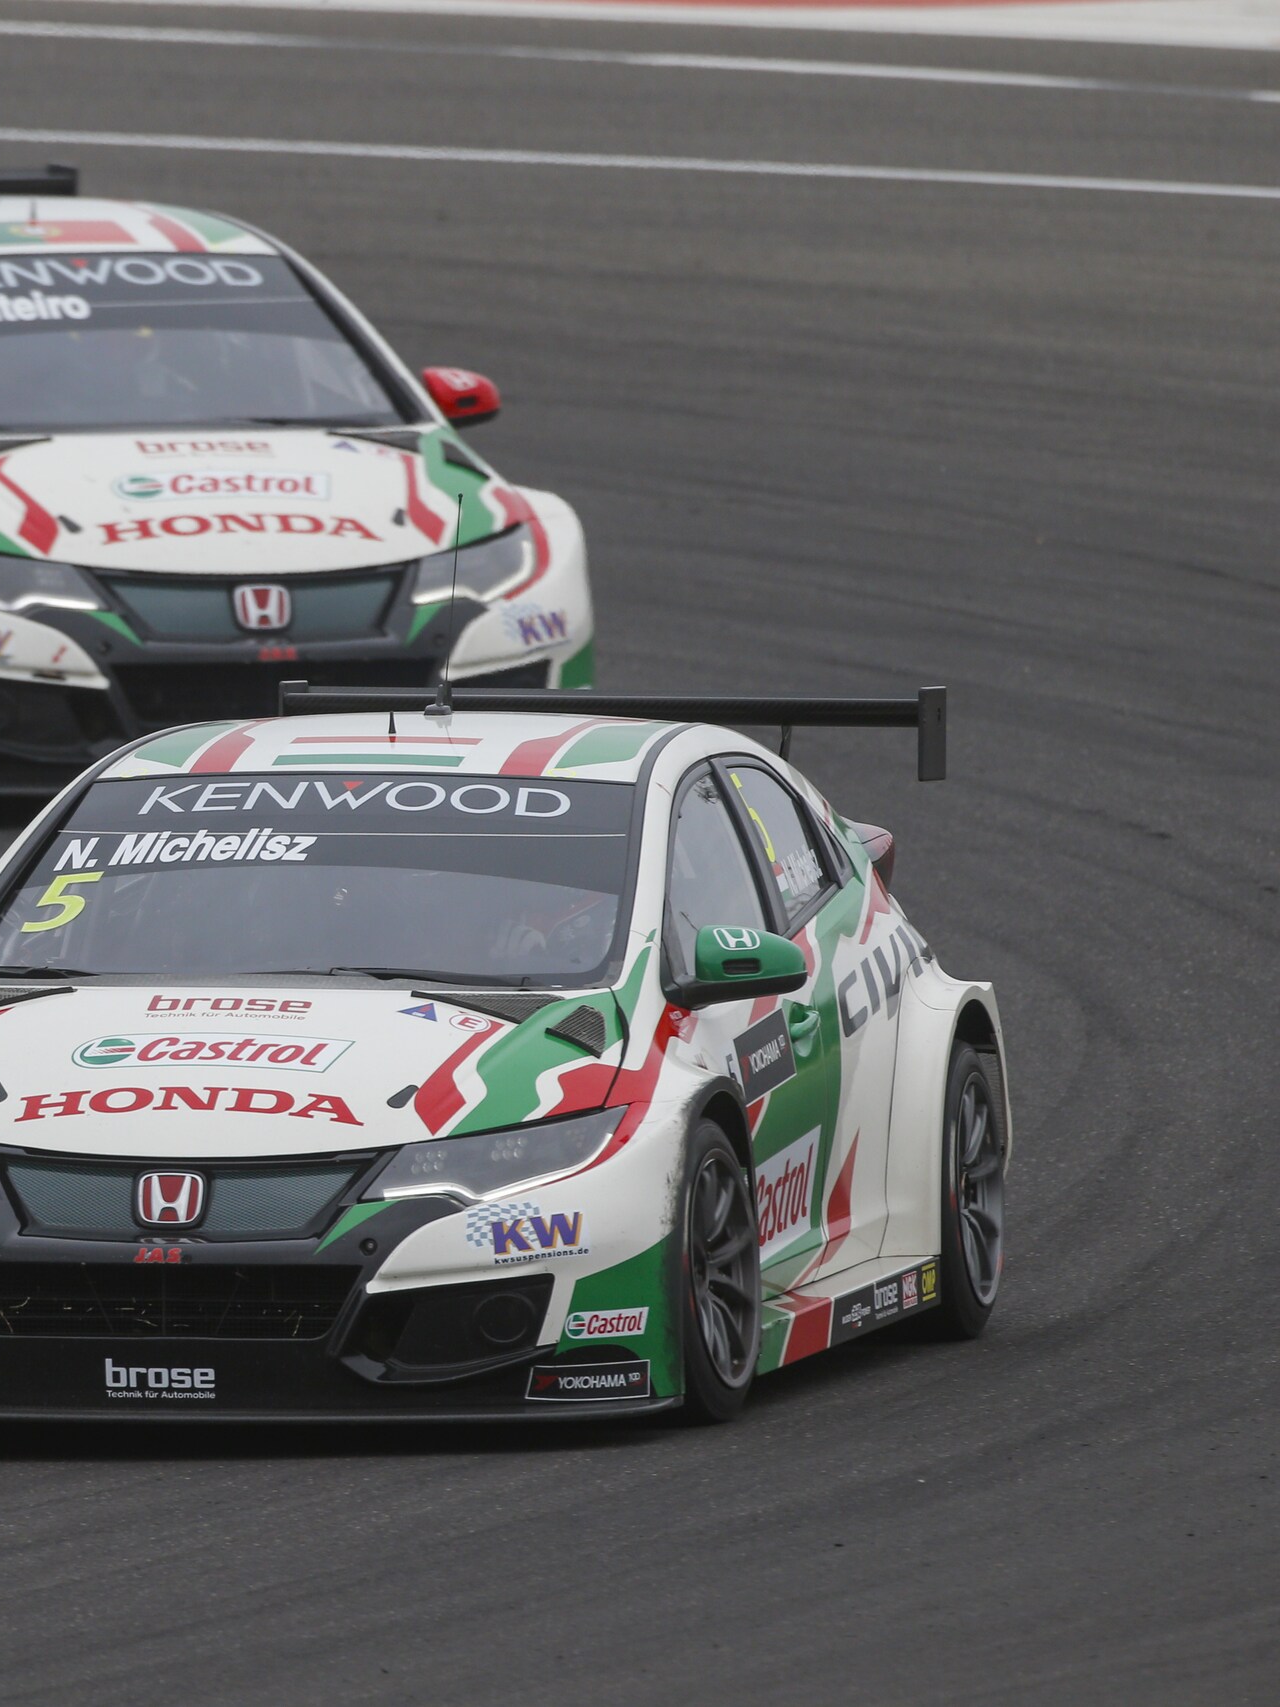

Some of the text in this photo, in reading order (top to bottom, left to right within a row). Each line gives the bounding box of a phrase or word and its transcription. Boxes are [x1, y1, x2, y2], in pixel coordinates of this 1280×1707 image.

[171, 474, 317, 495] Castrol
[97, 513, 384, 545] HONDA
[517, 609, 567, 646] KW
[137, 781, 571, 819] KENWOOD
[53, 828, 318, 872] N. Michelisz
[20, 870, 105, 933] 5
[145, 1011, 196, 1019] Technik
[224, 1012, 306, 1021] Automobile
[147, 994, 313, 1014] brose
[136, 1037, 329, 1066] Castrol
[13, 1086, 365, 1127] HONDA
[491, 1211, 583, 1256] KW
[133, 1247, 183, 1264] JAS
[494, 1247, 590, 1265] kwsuspensions.de
[586, 1311, 643, 1335] Castrol
[105, 1358, 216, 1389] brose
[558, 1374, 627, 1389] YOKOHAMA
[105, 1389, 216, 1399] Technik für Automobile
